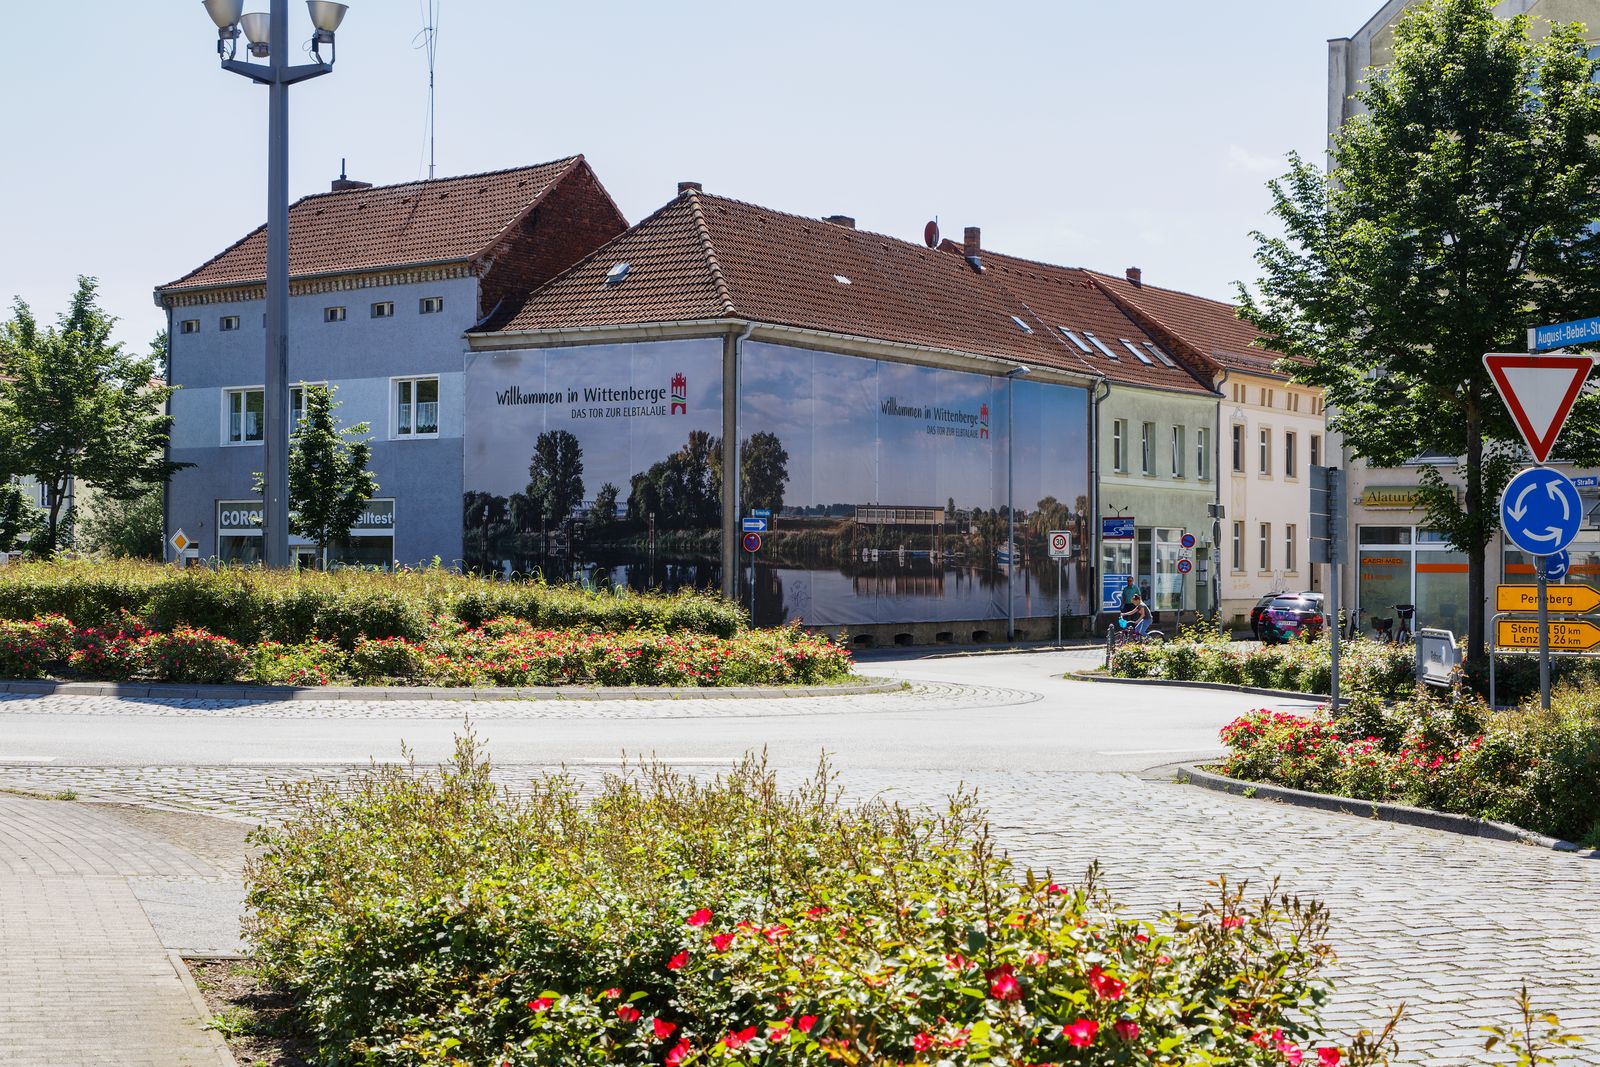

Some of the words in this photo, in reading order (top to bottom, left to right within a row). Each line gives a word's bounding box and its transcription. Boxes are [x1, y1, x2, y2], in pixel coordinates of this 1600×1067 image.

[496, 385, 563, 406] Willkommen
[567, 387, 578, 403] in
[584, 386, 666, 404] Wittenberge
[571, 408, 587, 419] DAS
[589, 408, 603, 418] TOR
[605, 407, 621, 417] ZUR
[623, 406, 666, 417] ELBTALAUE
[880, 396, 922, 419] Willkommen
[924, 404, 931, 420] in
[934, 407, 978, 428] Wittenberge
[927, 424, 936, 435] DAS
[955, 428, 978, 439] ELBTALAUE
[1367, 491, 1418, 502] Alaturk
[221, 510, 263, 526] CORO
[354, 512, 392, 524] elltest
[1056, 538, 1063, 546] 30
[1521, 594, 1573, 606] Perberg
[1511, 624, 1550, 634] Stenl
[1553, 625, 1565, 635] 50
[1568, 627, 1581, 635] km
[1513, 634, 1551, 644] Lenzn
[1553, 635, 1565, 645] 26
[1568, 637, 1581, 645] km
